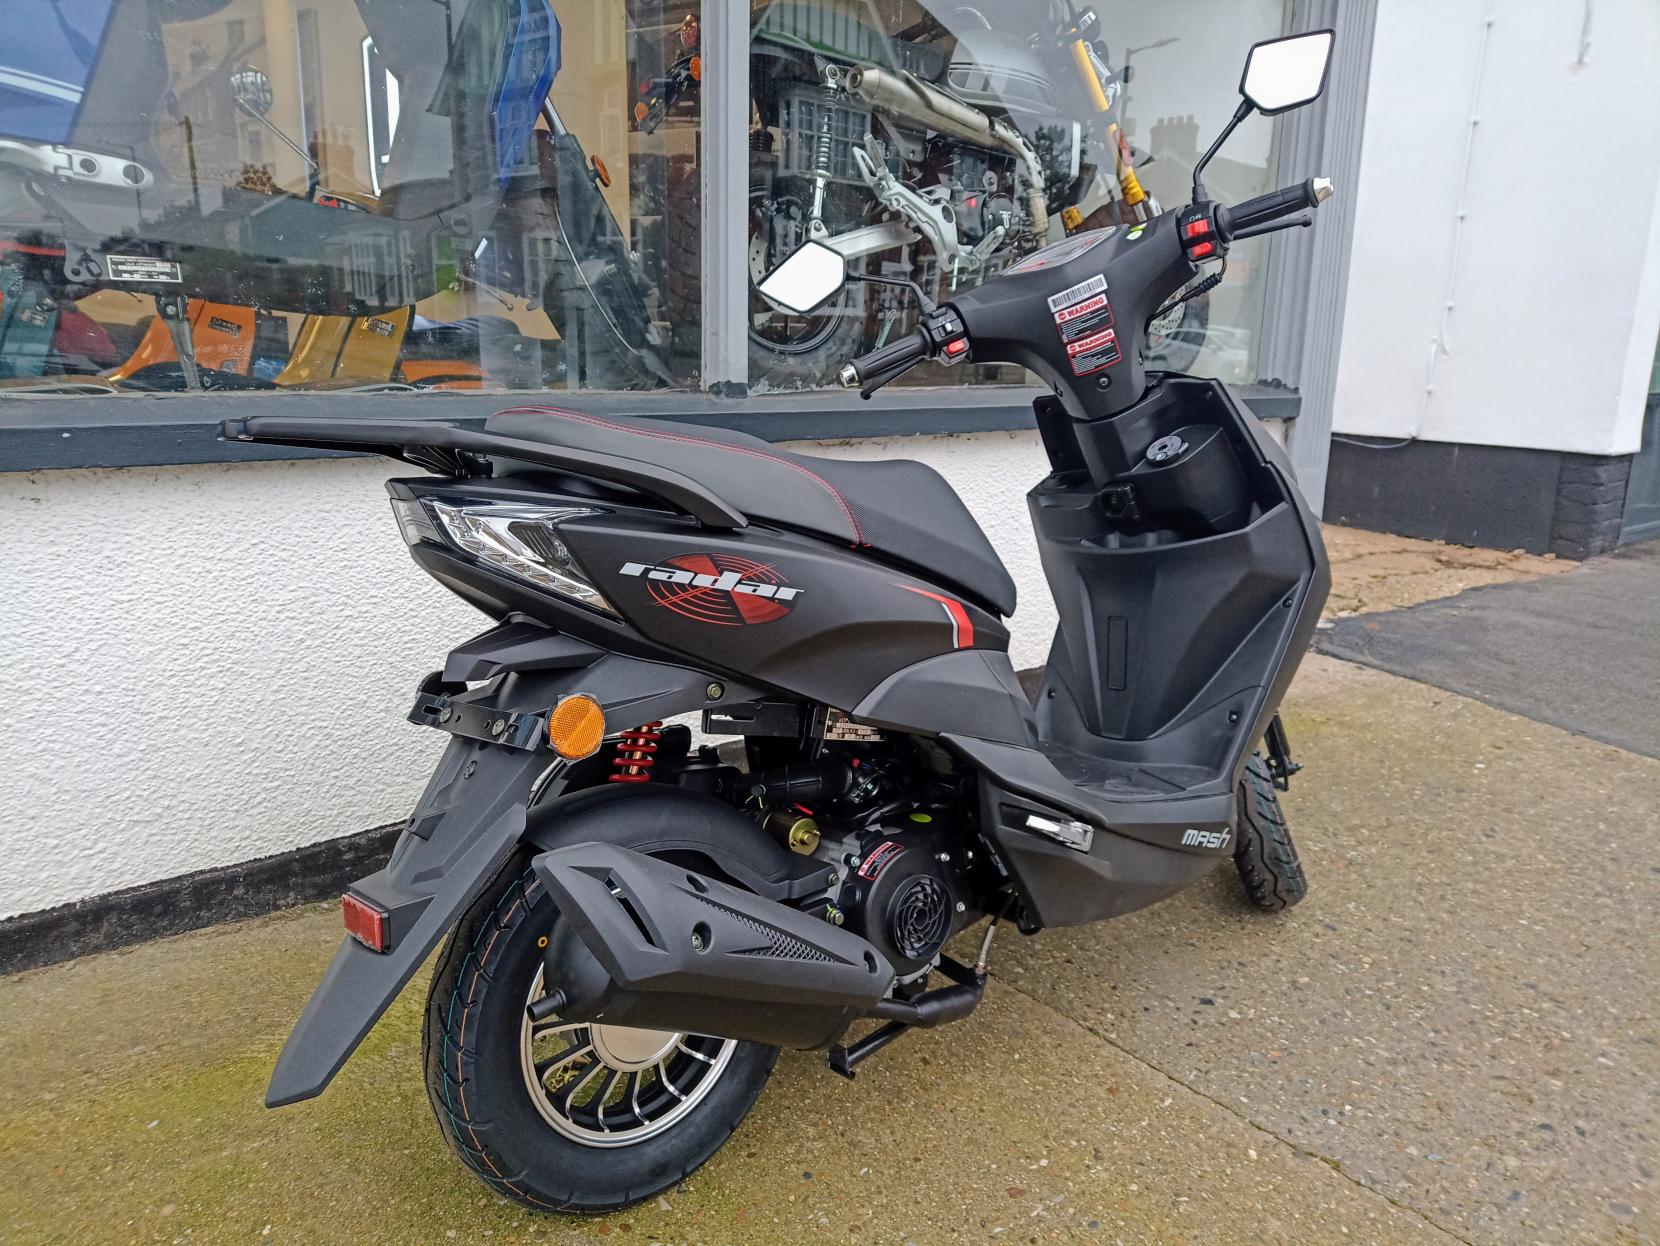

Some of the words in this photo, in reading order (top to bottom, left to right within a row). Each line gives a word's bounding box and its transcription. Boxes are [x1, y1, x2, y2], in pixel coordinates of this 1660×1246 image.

[1067, 297, 1104, 317] WARNING
[1077, 331, 1112, 349] WARNING
[618, 562, 805, 601] radar
